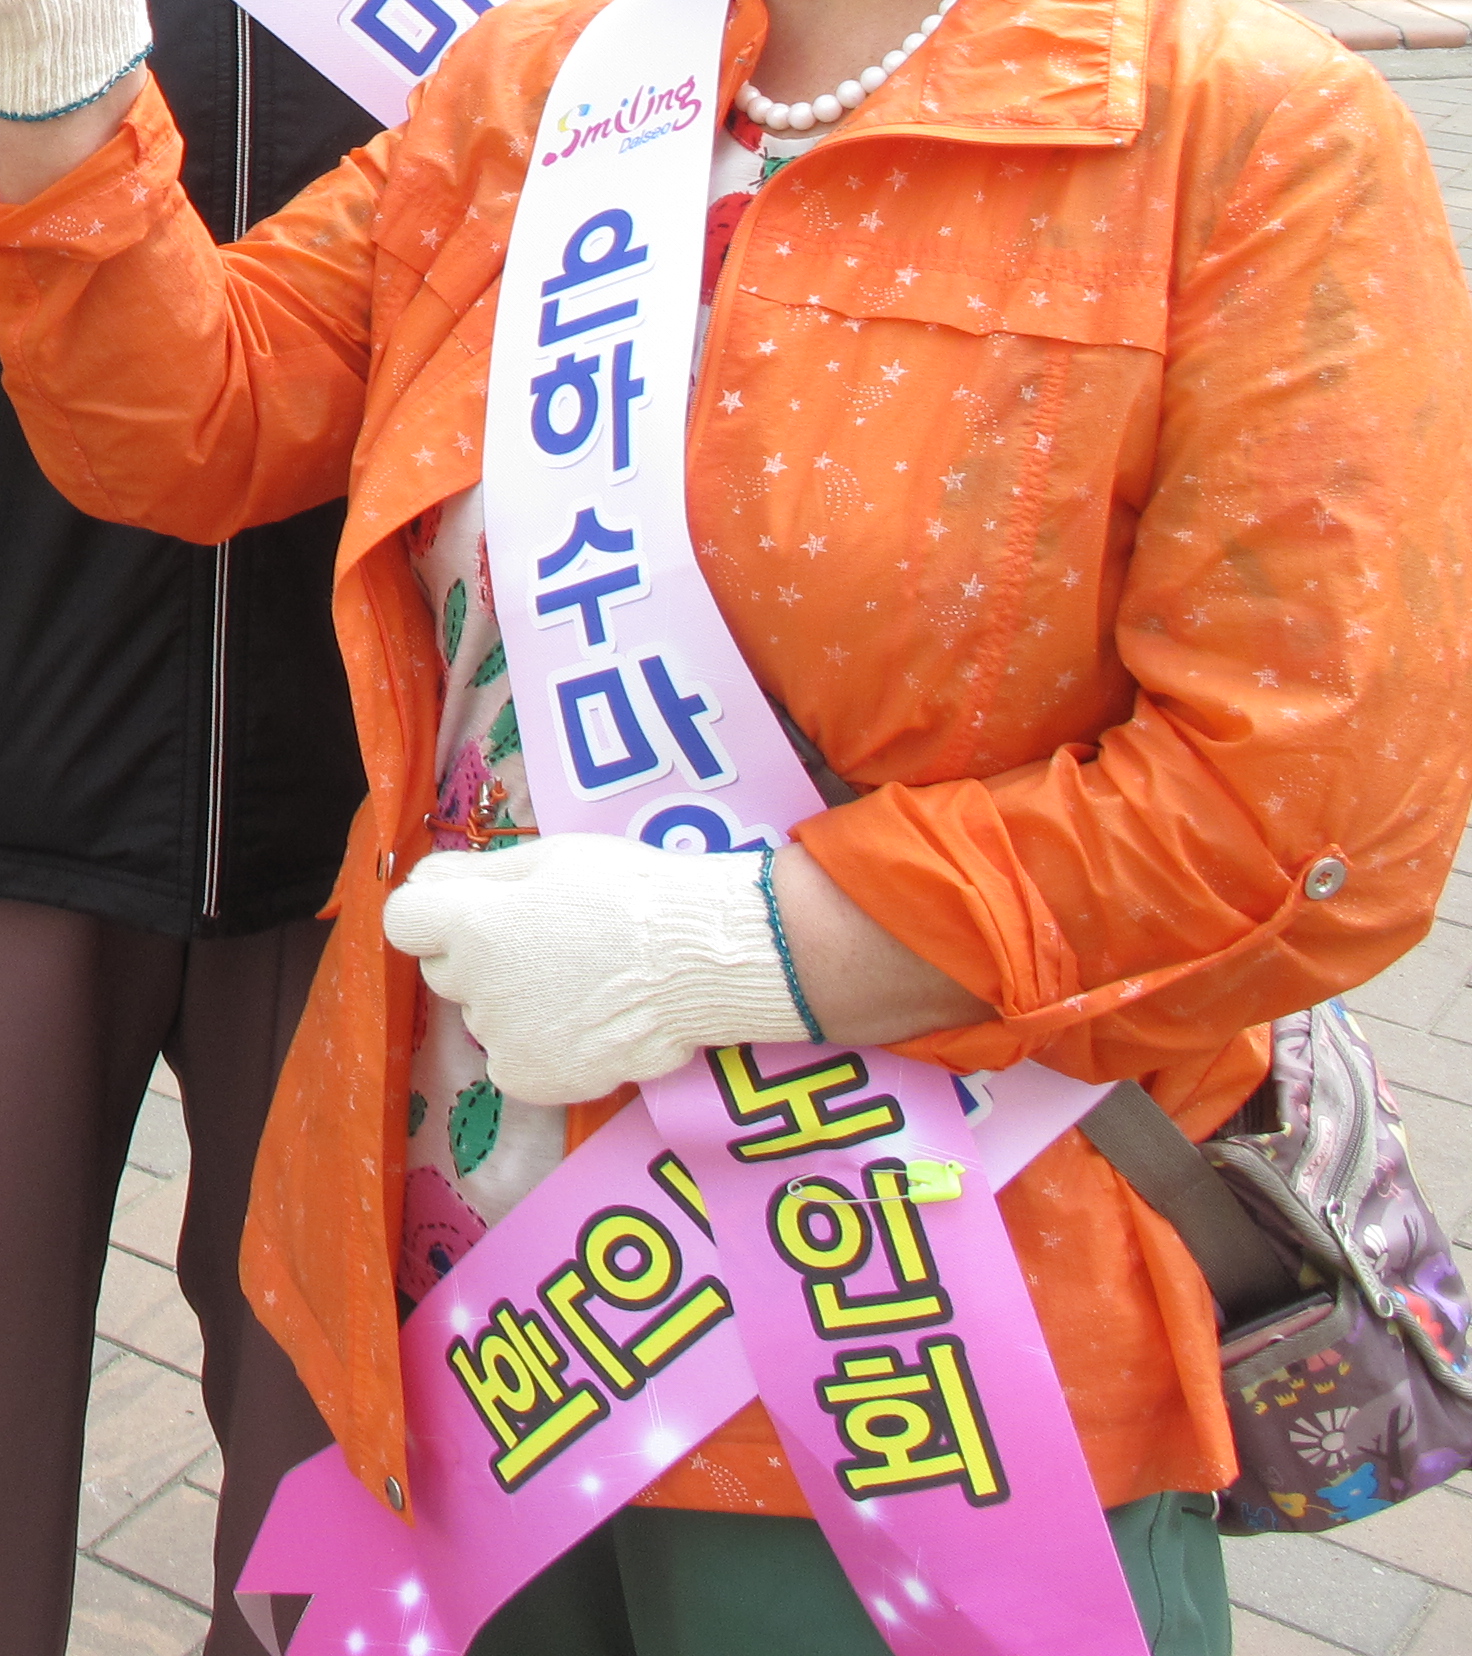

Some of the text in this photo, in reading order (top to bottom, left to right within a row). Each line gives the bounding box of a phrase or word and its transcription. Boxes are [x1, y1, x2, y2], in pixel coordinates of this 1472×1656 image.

[541, 75, 703, 167] Smiling
[618, 122, 672, 154] Dalseo
[446, 1148, 734, 1493] 인회
[706, 1045, 1011, 1508] 노인회
